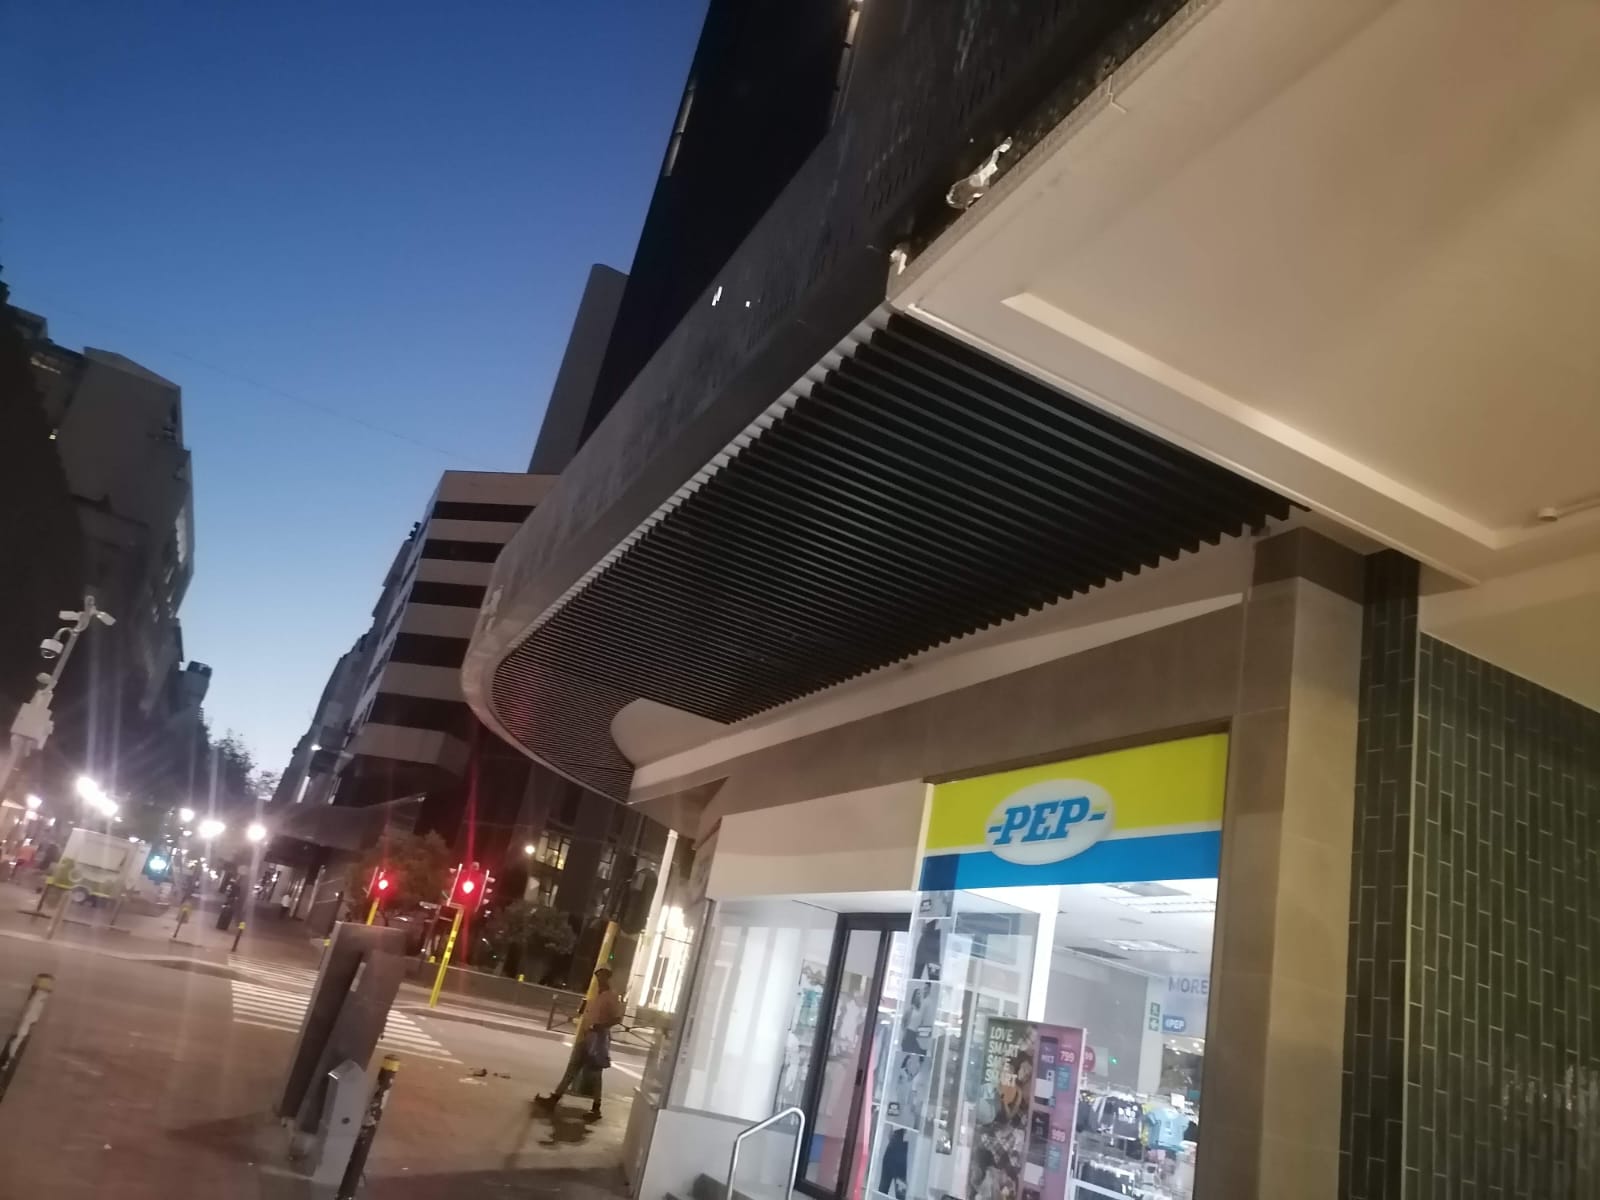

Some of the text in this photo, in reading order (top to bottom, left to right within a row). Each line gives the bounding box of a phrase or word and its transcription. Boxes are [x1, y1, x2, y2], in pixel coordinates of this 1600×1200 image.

[1168, 976, 1209, 995] MORE
[990, 1026, 1014, 1042] LOVE
[987, 1040, 1020, 1058] SMART
